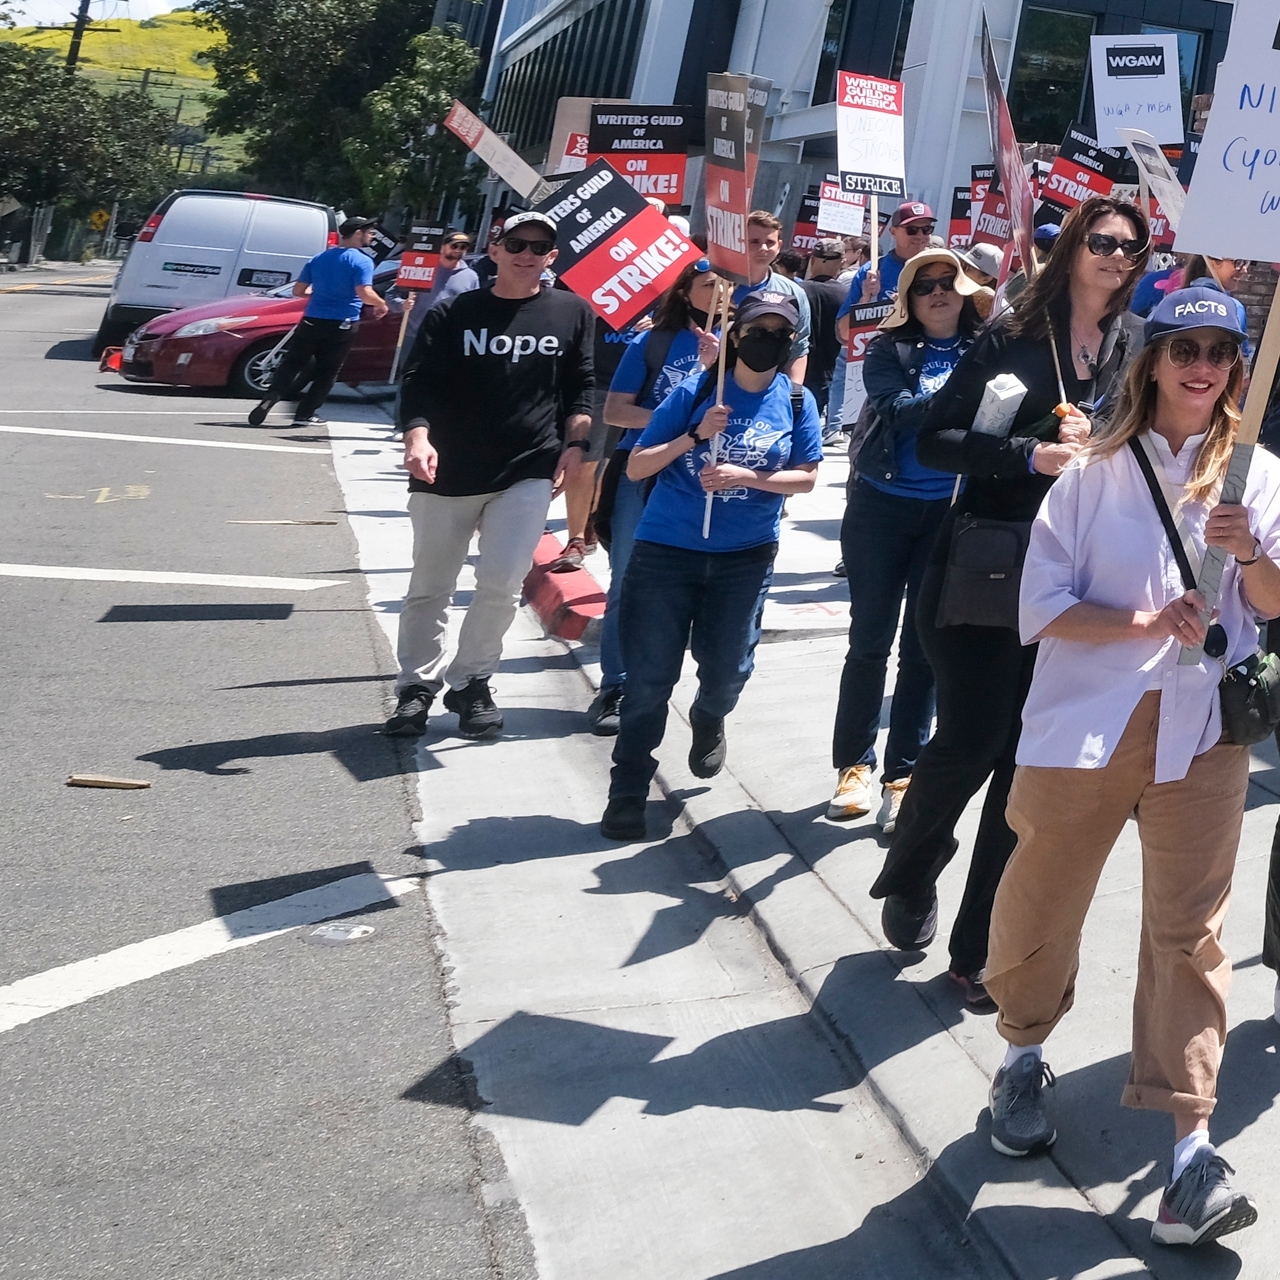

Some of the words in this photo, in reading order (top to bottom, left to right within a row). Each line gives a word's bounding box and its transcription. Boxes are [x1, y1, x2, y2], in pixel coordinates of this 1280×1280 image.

[1109, 55, 1162, 67] WGAW
[845, 76, 897, 95] WRITERS
[846, 86, 883, 101] GUILD
[843, 96, 898, 112] AMERICA
[597, 115, 648, 126] WRITERS
[651, 115, 683, 126] GUILD
[633, 128, 646, 136] OF
[612, 139, 663, 150] AMERICA
[626, 160, 647, 171] ON
[1073, 153, 1104, 172] AMERICA
[632, 174, 678, 194] IKE!
[845, 174, 901, 194] STRIKE
[1076, 172, 1090, 184] ON
[546, 195, 581, 223] TERS
[576, 170, 614, 200] GUILD
[1048, 175, 1098, 202] STRIK
[576, 208, 593, 223] OF
[569, 207, 627, 254] AMERICA
[707, 205, 746, 254] STRIKE!
[977, 213, 1011, 238] STRIKE!
[609, 238, 638, 261] ON
[399, 266, 435, 281] STRIKE!
[591, 229, 690, 315] STRIKE!
[1175, 301, 1227, 317] FACTS
[463, 328, 564, 363] Nope.
[674, 355, 700, 366] GUIL
[727, 418, 753, 426] UILD
